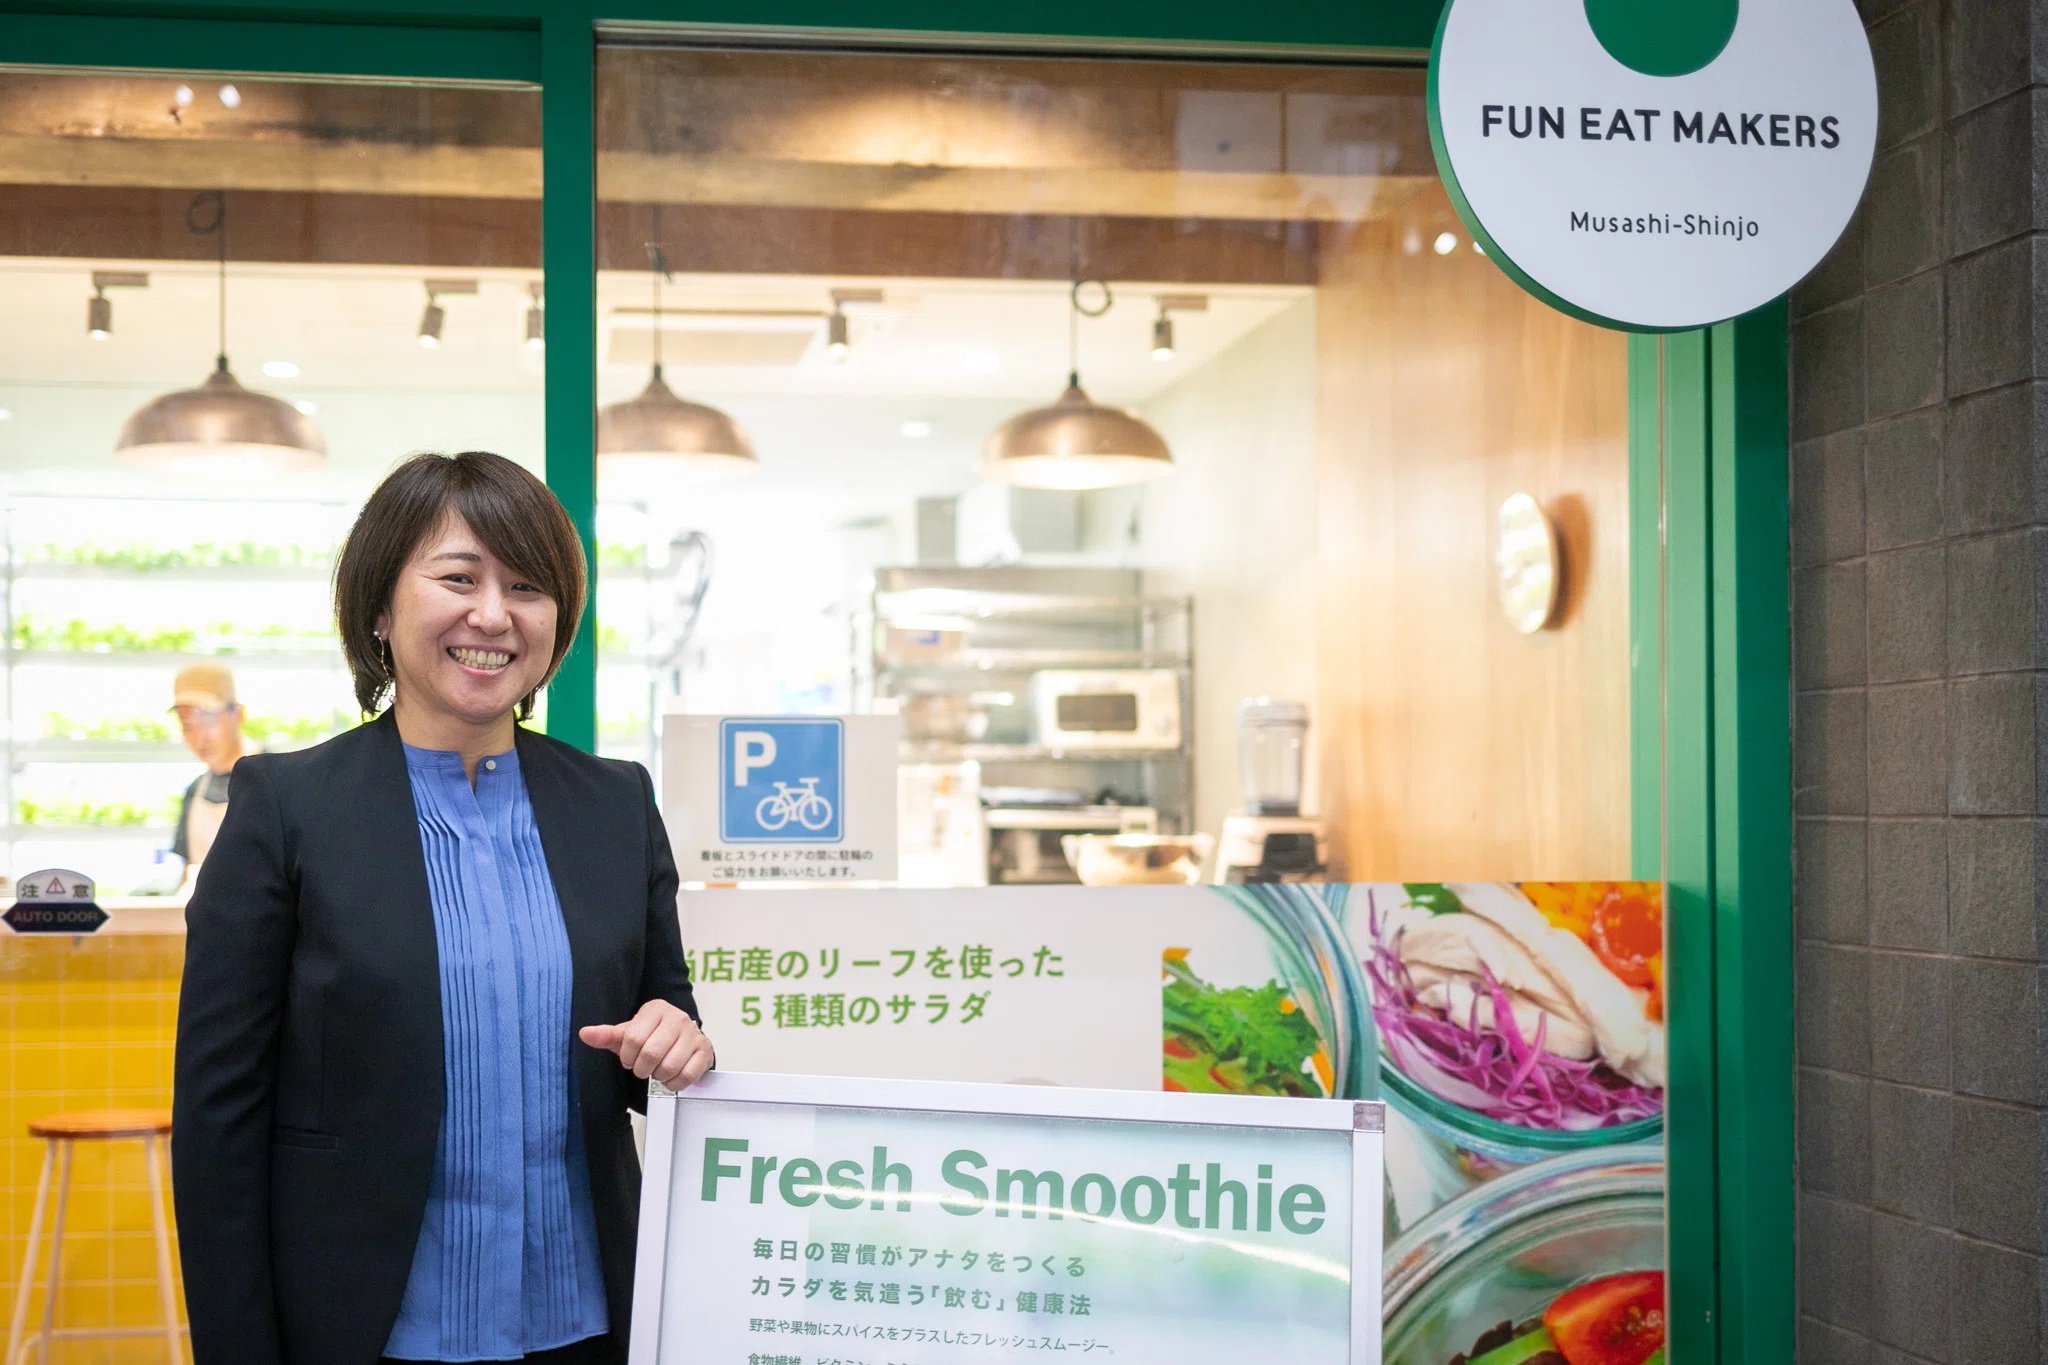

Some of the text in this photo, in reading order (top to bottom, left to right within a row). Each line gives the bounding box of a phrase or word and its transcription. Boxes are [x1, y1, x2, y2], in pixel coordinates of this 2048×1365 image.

[1482, 104, 1840, 149] FUN EAT MAKERS
[1570, 211, 1759, 241] Musashi-Shinjo
[734, 731, 777, 787] P
[701, 850, 873, 862] 看板とスライドドアの間に駐輪の
[712, 866, 857, 878] ご協力をお願いいたします。
[21, 883, 90, 898] 注 意
[14, 911, 98, 922] AUTO DOOR
[741, 991, 992, 1029] 5種類のサラダ
[701, 1137, 1327, 1235] Fresh Smoothie
[753, 1238, 1086, 1278] 毎日の習慣がアナタをつくる
[751, 1275, 1091, 1316] カラダを気遣う「飲む」健康法
[750, 1318, 1115, 1355] 野菜や果物にスパイスをプラスしたフレッシュスムージー。
